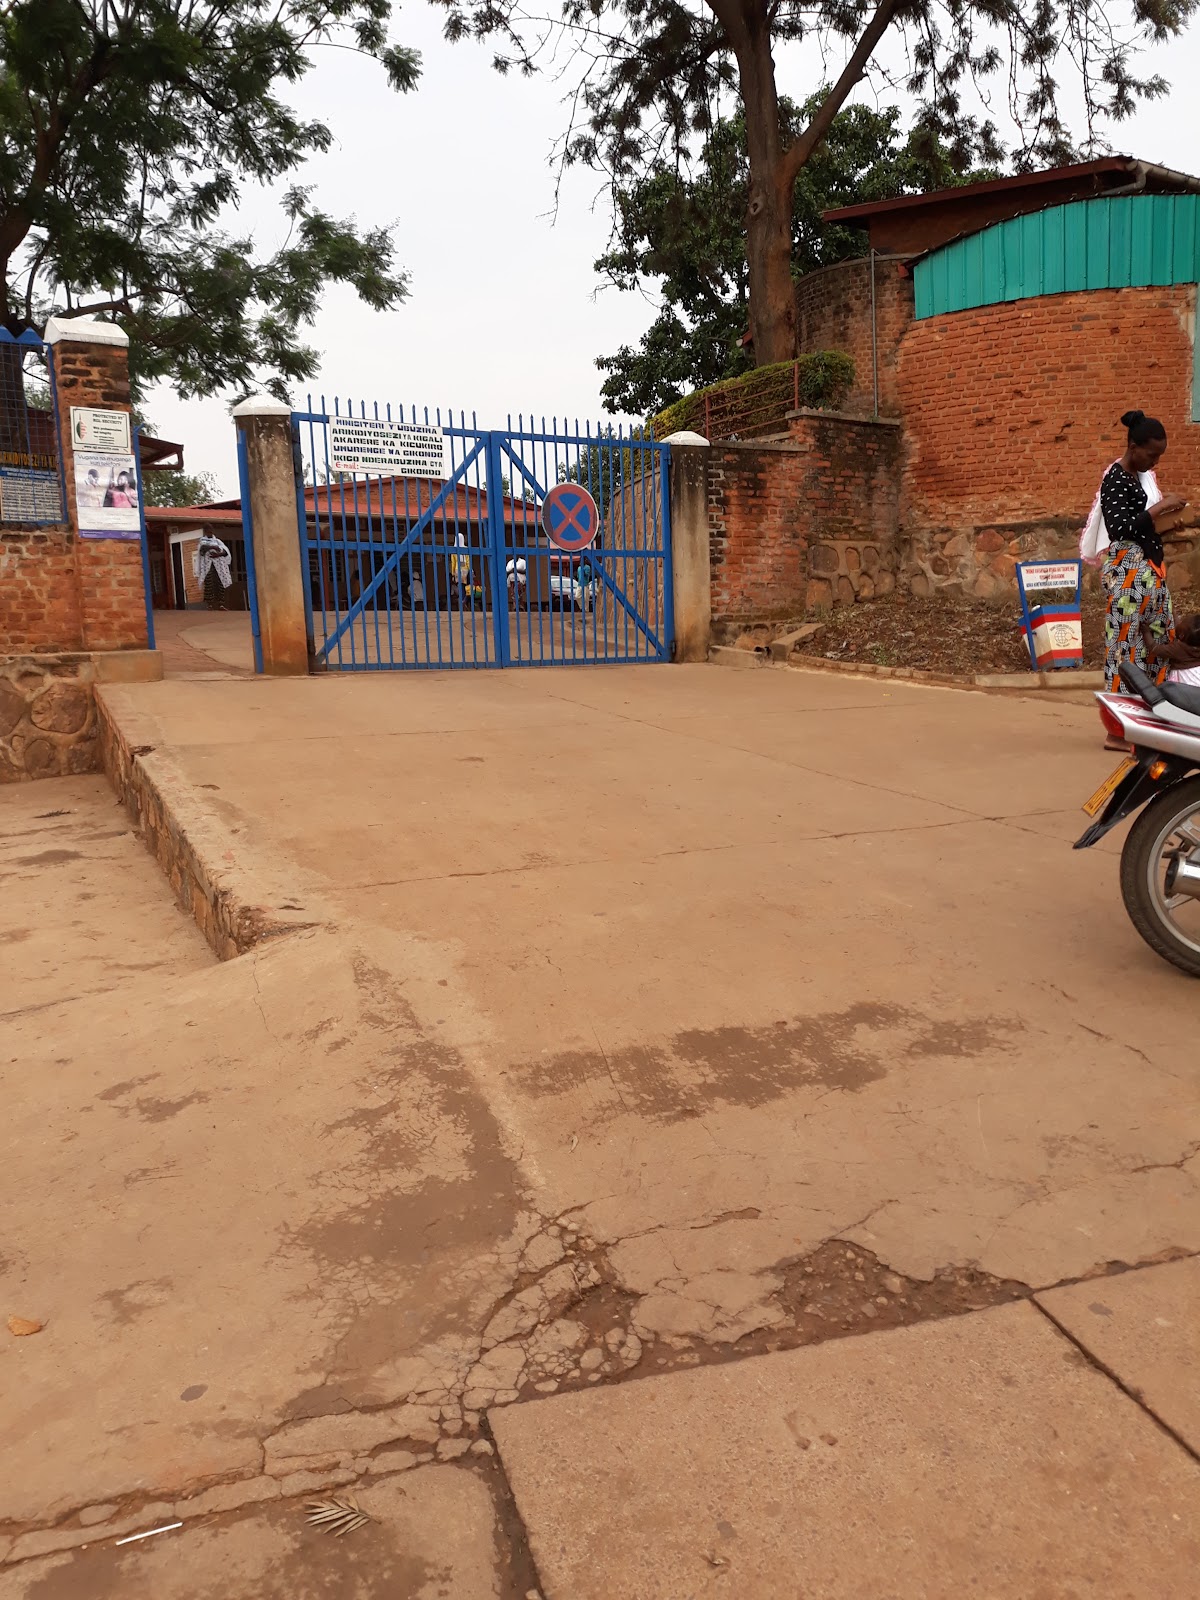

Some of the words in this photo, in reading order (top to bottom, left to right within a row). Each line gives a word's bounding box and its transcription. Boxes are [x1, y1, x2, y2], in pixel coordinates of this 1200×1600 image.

[336, 419, 385, 430] MINISITERI
[332, 428, 402, 439] ARIKIDIYOSEZI
[413, 435, 443, 443] KIGALI
[333, 436, 379, 446] AKARERE
[400, 441, 443, 450] KICUKIRO
[333, 445, 386, 455] UMURENGE
[403, 450, 443, 458] GIKONDO
[333, 454, 359, 462] IKIGO
[362, 456, 427, 467] NDERABUZIMA
[335, 461, 359, 470] E-mail:
[400, 467, 441, 476] GIKONDO
